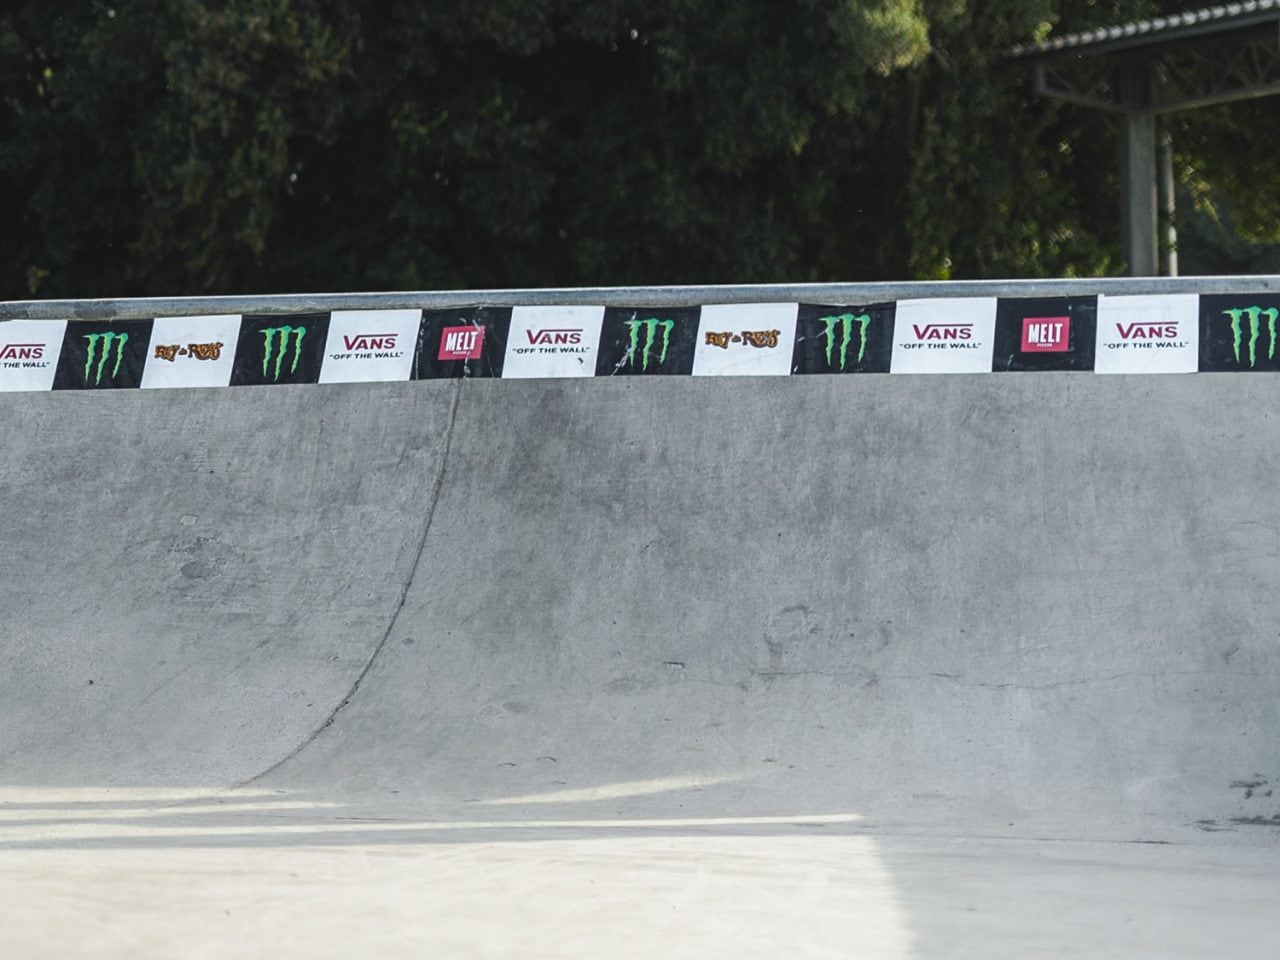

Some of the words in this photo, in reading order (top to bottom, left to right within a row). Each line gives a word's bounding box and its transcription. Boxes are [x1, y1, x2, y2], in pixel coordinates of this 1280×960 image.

[526, 328, 583, 345] VANS
[912, 323, 974, 340] VANS
[1028, 322, 1063, 344] MELT
[1116, 321, 1179, 339] VANS
[343, 333, 398, 350] VANS
[445, 331, 478, 352] MELT
